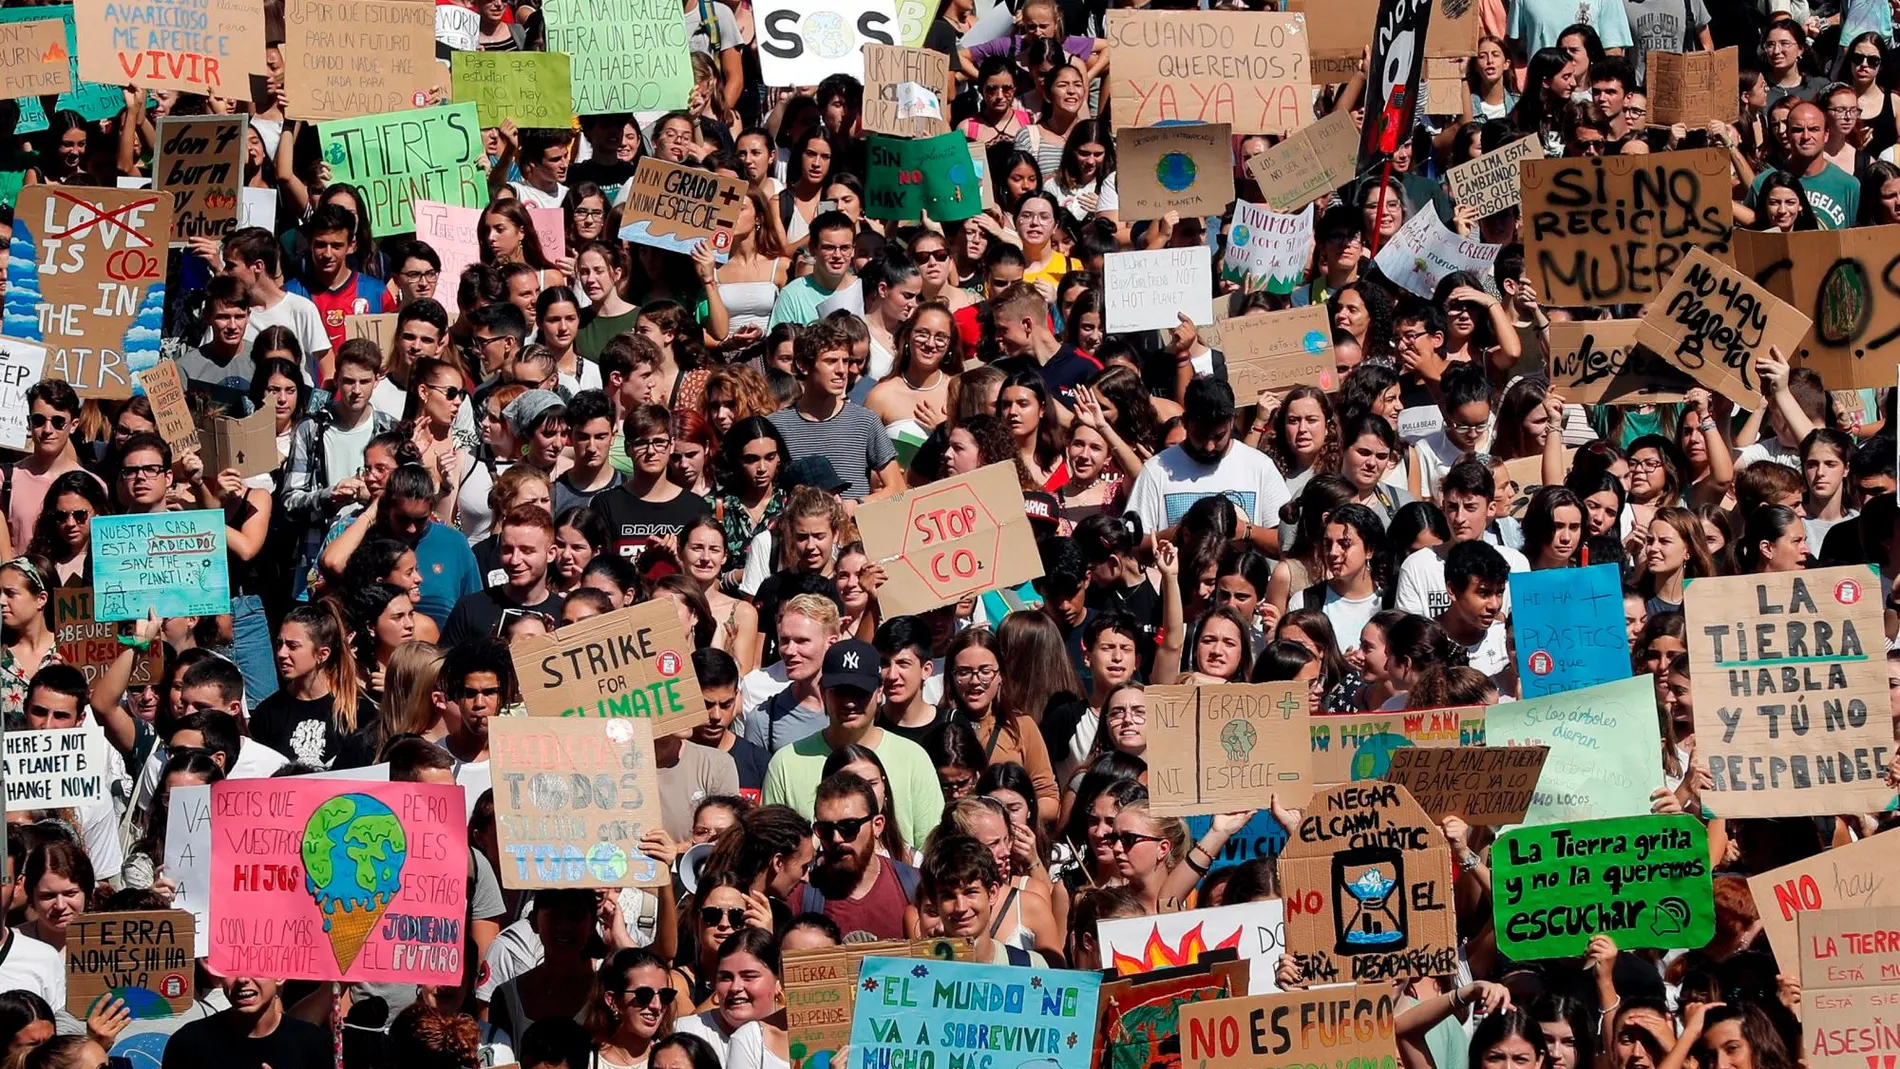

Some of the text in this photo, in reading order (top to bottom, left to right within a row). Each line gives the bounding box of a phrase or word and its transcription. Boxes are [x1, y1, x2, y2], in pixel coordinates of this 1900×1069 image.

[104, 4, 208, 30] AVARICIOSO
[365, 3, 433, 26] ESTUDIAMOS
[566, 0, 684, 24] LA NATURALEZA
[112, 27, 140, 49] ME
[305, 30, 410, 51] PARA UN FUTURO
[548, 23, 688, 55] FUERA UN BANCO,
[1254, 24, 1284, 48] LO
[118, 51, 220, 86] VIVIR
[303, 53, 414, 74] CUANDO NADIE HACE
[465, 55, 496, 69] Para
[600, 49, 678, 81] HABRÍAN
[868, 47, 885, 82] UR
[1158, 53, 1302, 81] QUEREMOS?
[6, 71, 64, 91] FUTURE
[326, 76, 385, 87] NADA PARA
[462, 72, 508, 83] estudiar
[483, 85, 542, 103] NO hay
[1129, 80, 1299, 130] YA YA YA
[865, 98, 888, 131] OUR
[164, 125, 239, 155] don't
[331, 113, 469, 180] THERE'S
[872, 147, 900, 167] SIN
[1260, 157, 1276, 171] LOS
[1454, 138, 1531, 184] EL CLIMA ESTÁ
[165, 158, 231, 185] burn
[899, 170, 923, 184] NO
[1270, 169, 1282, 181] NO
[376, 163, 479, 227] PLANET B
[664, 170, 718, 202] GRADO
[1634, 166, 1700, 208] NO
[654, 193, 720, 231] ESPECIE
[1167, 196, 1203, 206] PLANETA
[44, 197, 156, 250] LOVE
[178, 210, 237, 237] future
[1242, 206, 1296, 234] VIVIMOS
[38, 239, 85, 275] IS
[1171, 250, 1195, 266] HOT
[1458, 240, 1500, 260] CRECEN
[1177, 268, 1198, 284] NOT
[1684, 264, 1716, 297] NO
[93, 282, 138, 317] IN
[1121, 291, 1185, 308] HOT PLANET
[35, 303, 86, 336] THE
[1675, 335, 1704, 369] B
[54, 348, 126, 389] AIR
[166, 419, 183, 435] KIM
[100, 520, 197, 539] NUESTRA CASA
[914, 505, 975, 544] STOP
[101, 537, 211, 556] ESTA ARDIENDO
[119, 555, 180, 571] SAVE THE
[140, 570, 182, 586] PLANET!
[58, 594, 91, 623] NI
[1523, 591, 1572, 607] HI HA
[1756, 578, 1818, 616] LA
[65, 623, 113, 642] BEURE
[541, 628, 657, 689] STRIKE
[597, 675, 627, 694] FOR
[1728, 664, 1847, 697] HABLA
[1155, 693, 1271, 728] NI GRADO
[1568, 705, 1617, 728] árboles
[1717, 696, 1868, 743] Y TÚ NO
[61, 733, 87, 751] NOT
[1341, 721, 1390, 748] HAY
[1552, 722, 1600, 750] dieran
[20, 753, 87, 775] PLANET B
[1394, 751, 1546, 772] SI EL PLANETA FUERA
[1708, 746, 1888, 792] RESPONDES
[62, 776, 101, 800] NOW!
[503, 772, 644, 811] TODOS
[1156, 762, 1273, 795] NI ESPECIE
[1489, 774, 1503, 788] YA
[1508, 774, 1527, 787] LO
[269, 791, 296, 818] QUE
[403, 794, 448, 822] PERO
[1328, 785, 1401, 811] NEGAR
[1465, 791, 1531, 814] RESCATADO
[1557, 792, 1590, 805] LOCOS
[225, 828, 302, 855] VUESTROS
[1300, 816, 1332, 843] EL
[411, 834, 448, 860] LES
[1509, 827, 1692, 867] La Tierra grita
[234, 864, 299, 892] HIJOS
[403, 873, 460, 905] ESTÁIS
[1505, 857, 1705, 905] y no la queremos
[1286, 881, 1445, 922] NO EL
[1774, 862, 1884, 922] NO hay
[70, 920, 175, 946] TERRA
[216, 916, 313, 945] SON LO MÁS
[382, 913, 460, 944] JODIENDO
[1505, 900, 1648, 943] escuchar
[71, 944, 186, 973] NOMÉS HA
[226, 945, 320, 973] IMPORTANTE
[363, 942, 459, 973] EL FUTURO
[1813, 932, 1838, 959] LA
[103, 972, 148, 989] UNA
[1828, 963, 1865, 981] ESTÁ
[883, 977, 1079, 1017] EL MUNDO NO
[791, 1008, 846, 1028] DEPENDE
[1189, 994, 1395, 1060] NO ES FUEGO
[869, 1018, 900, 1043] VA
[916, 1022, 931, 1045] A
[940, 1023, 1061, 1054] SOBREVIVIR
[863, 1047, 935, 1069] MUCHO
